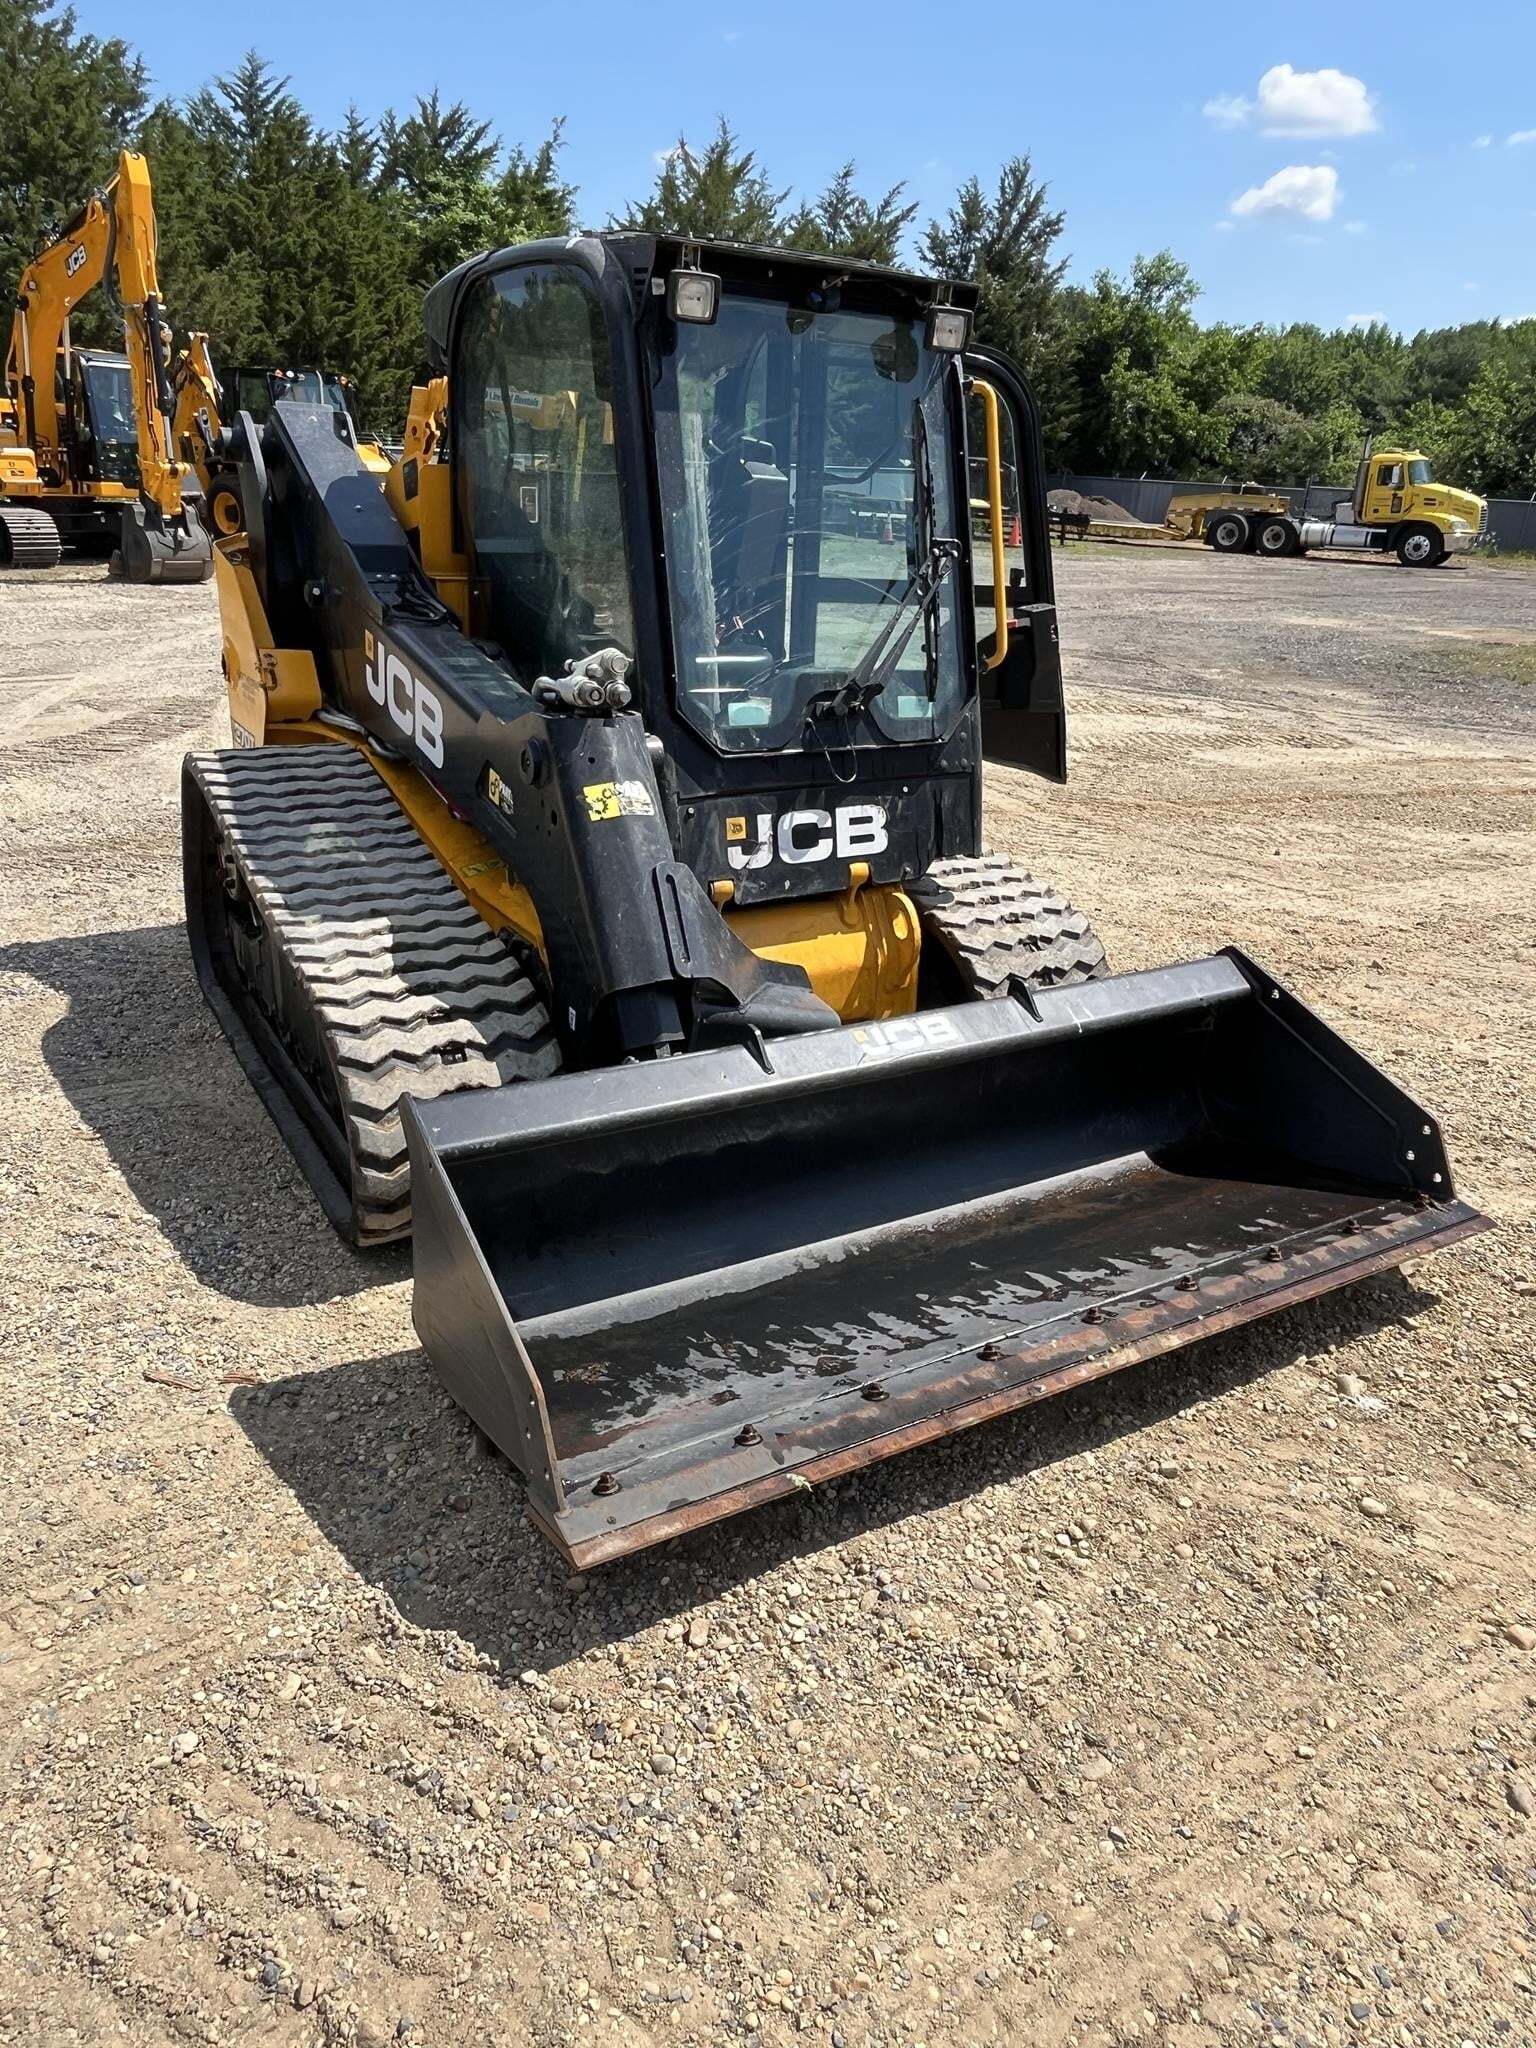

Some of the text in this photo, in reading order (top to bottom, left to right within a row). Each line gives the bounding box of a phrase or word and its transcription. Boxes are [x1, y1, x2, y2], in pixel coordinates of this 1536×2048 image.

[67, 244, 87, 277] JCB
[365, 640, 444, 769] JCB
[727, 804, 889, 870] JCB
[855, 1013, 961, 1057] JCB
